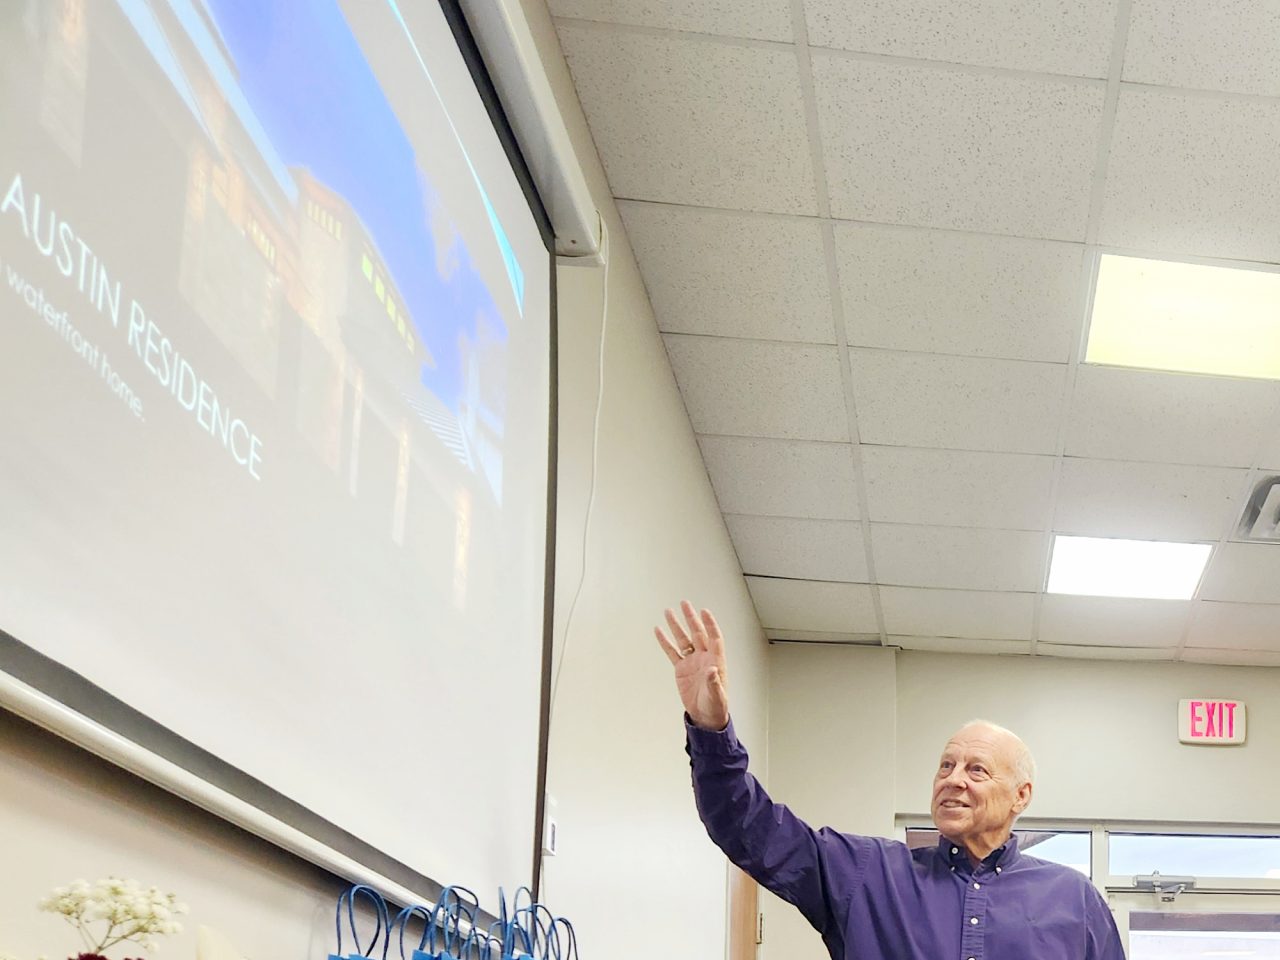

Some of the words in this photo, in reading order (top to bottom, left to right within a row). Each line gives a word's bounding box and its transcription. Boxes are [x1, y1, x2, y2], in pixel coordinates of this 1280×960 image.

[1, 172, 121, 328] AUSTIN
[128, 299, 263, 481] RESIDENCE
[6, 264, 99, 369] waterfront
[1191, 701, 1237, 738] EXIT
